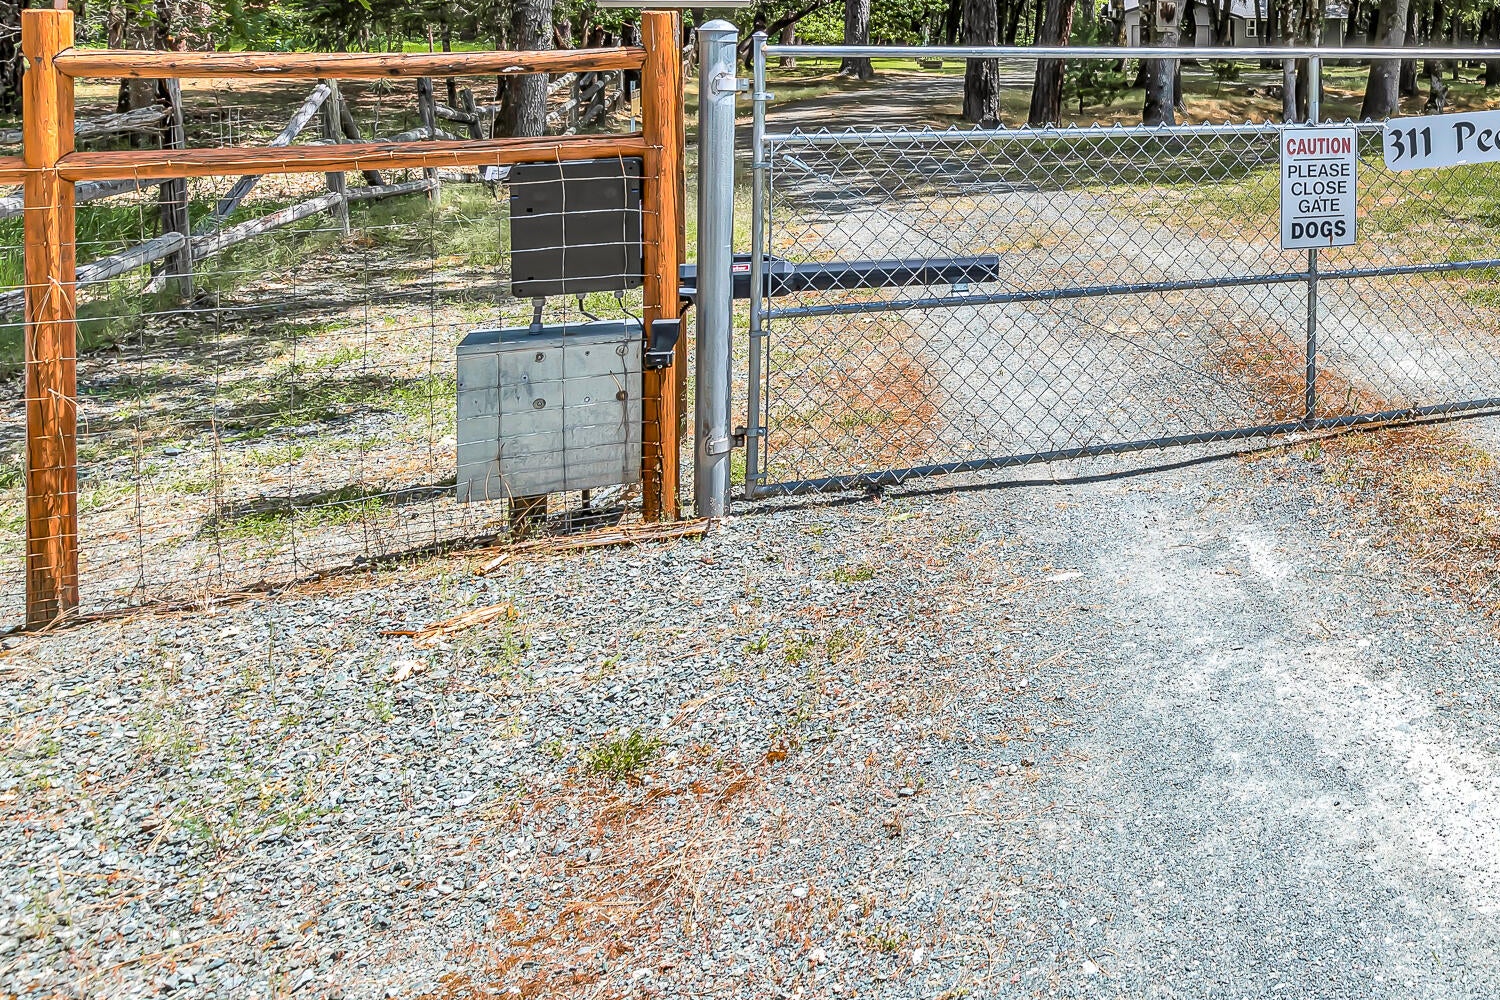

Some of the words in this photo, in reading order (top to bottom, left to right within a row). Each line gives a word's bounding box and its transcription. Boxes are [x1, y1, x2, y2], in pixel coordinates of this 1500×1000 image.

[1286, 137, 1351, 155] CAUTION
[1388, 126, 1432, 163] 311
[1288, 163, 1350, 178] PLEASE
[1291, 180, 1347, 196] CLOSE
[1298, 198, 1340, 213] GATE
[1291, 220, 1346, 239] DOGS
